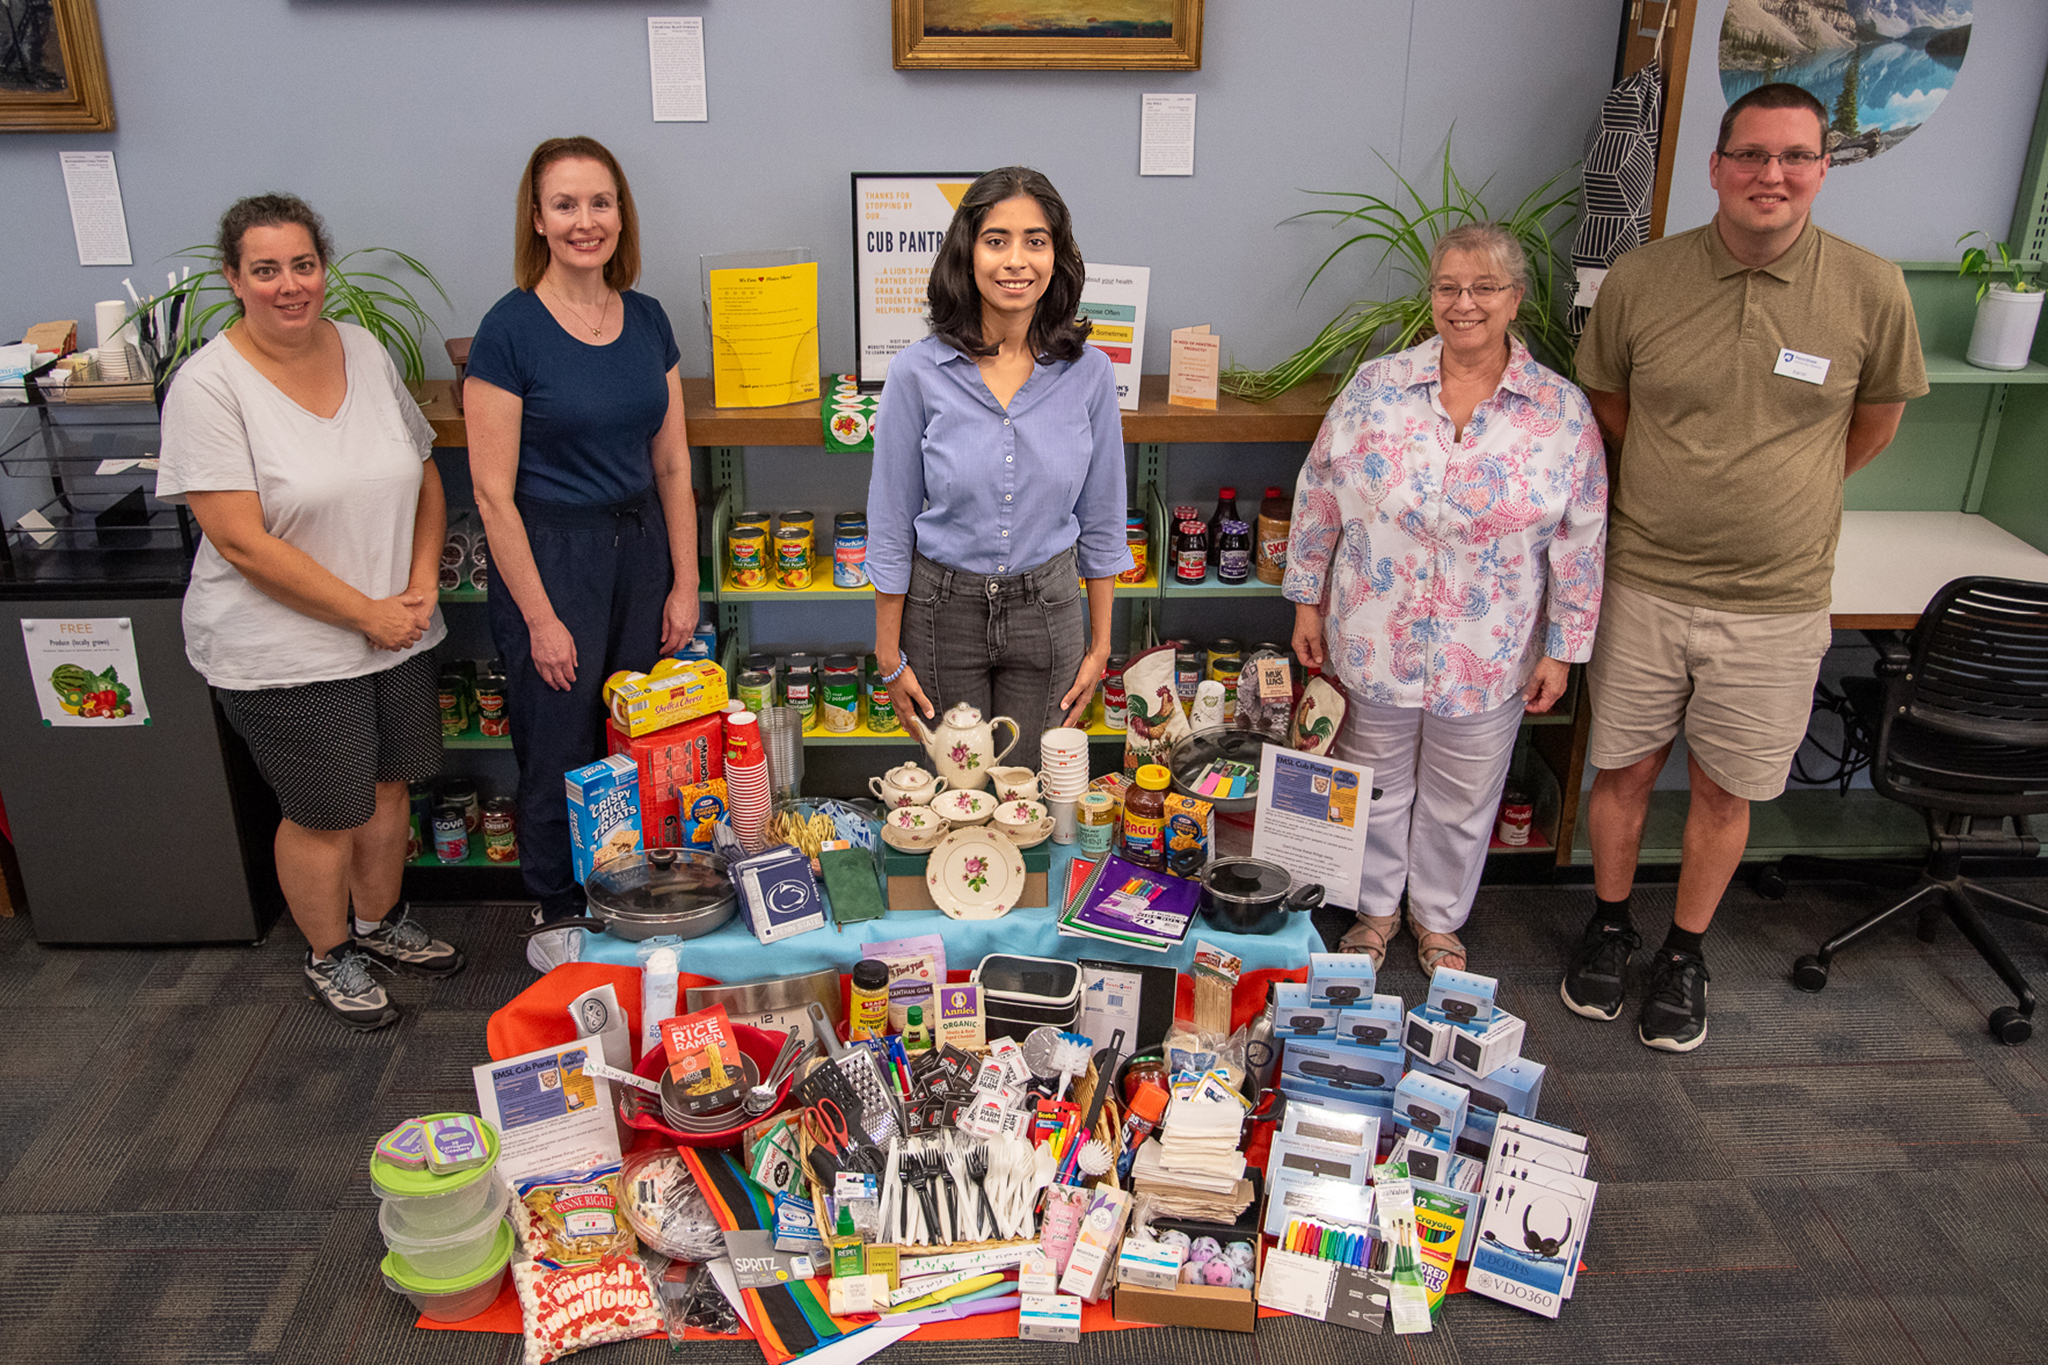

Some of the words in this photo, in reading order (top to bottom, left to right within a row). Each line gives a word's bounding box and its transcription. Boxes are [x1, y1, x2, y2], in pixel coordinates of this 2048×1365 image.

[867, 231, 893, 253] CUB
[900, 231, 947, 253] PANTR
[1081, 307, 1103, 315] Choose
[1096, 330, 1128, 338] Sometimes
[60, 624, 93, 633] FREE
[92, 639, 109, 647] grown)
[1266, 671, 1282, 679] MUK
[655, 702, 674, 715] Shells
[680, 694, 703, 705] Cheese
[1276, 755, 1294, 766] EMSL
[1294, 759, 1309, 770] Cub
[1309, 763, 1332, 777] Pantry
[592, 789, 631, 819] CRISPY
[601, 800, 628, 822] RICE
[435, 818, 464, 831] GOYA
[592, 805, 638, 841] TREATS
[1125, 820, 1157, 835] RAGÚ
[748, 878, 761, 901] PENN
[753, 902, 766, 926] STATE
[774, 925, 796, 936] PENN
[797, 918, 821, 928] STATE
[1135, 918, 1155, 926] 70
[761, 1014, 773, 1024] 12
[944, 1007, 975, 1016] Annie's
[672, 1020, 720, 1044] RICE
[943, 1021, 977, 1029] ORGANIC
[675, 1031, 724, 1052] RAMEN
[492, 1067, 514, 1080] EMSL
[514, 1063, 532, 1075] Cub
[531, 1056, 559, 1071] Pantry
[979, 1081, 997, 1091] PARM
[980, 1075, 999, 1084] LITTLE
[979, 1115, 999, 1125] ALARM
[981, 1109, 1001, 1119] PARM
[440, 1142, 473, 1151] Corrugated
[445, 1147, 470, 1155] Coasters
[555, 1197, 585, 1213] PENNE
[585, 1196, 614, 1208] RIGATE
[1416, 1197, 1427, 1208] 12
[1056, 1209, 1073, 1218] LOVE
[1054, 1225, 1070, 1234] AND
[1416, 1214, 1452, 1231] Crayola
[1480, 1252, 1531, 1276] VDOUHS
[546, 1275, 572, 1293] mini
[552, 1262, 634, 1304] marsh
[1493, 1278, 1552, 1308] VDO360
[545, 1288, 650, 1334] mallows
